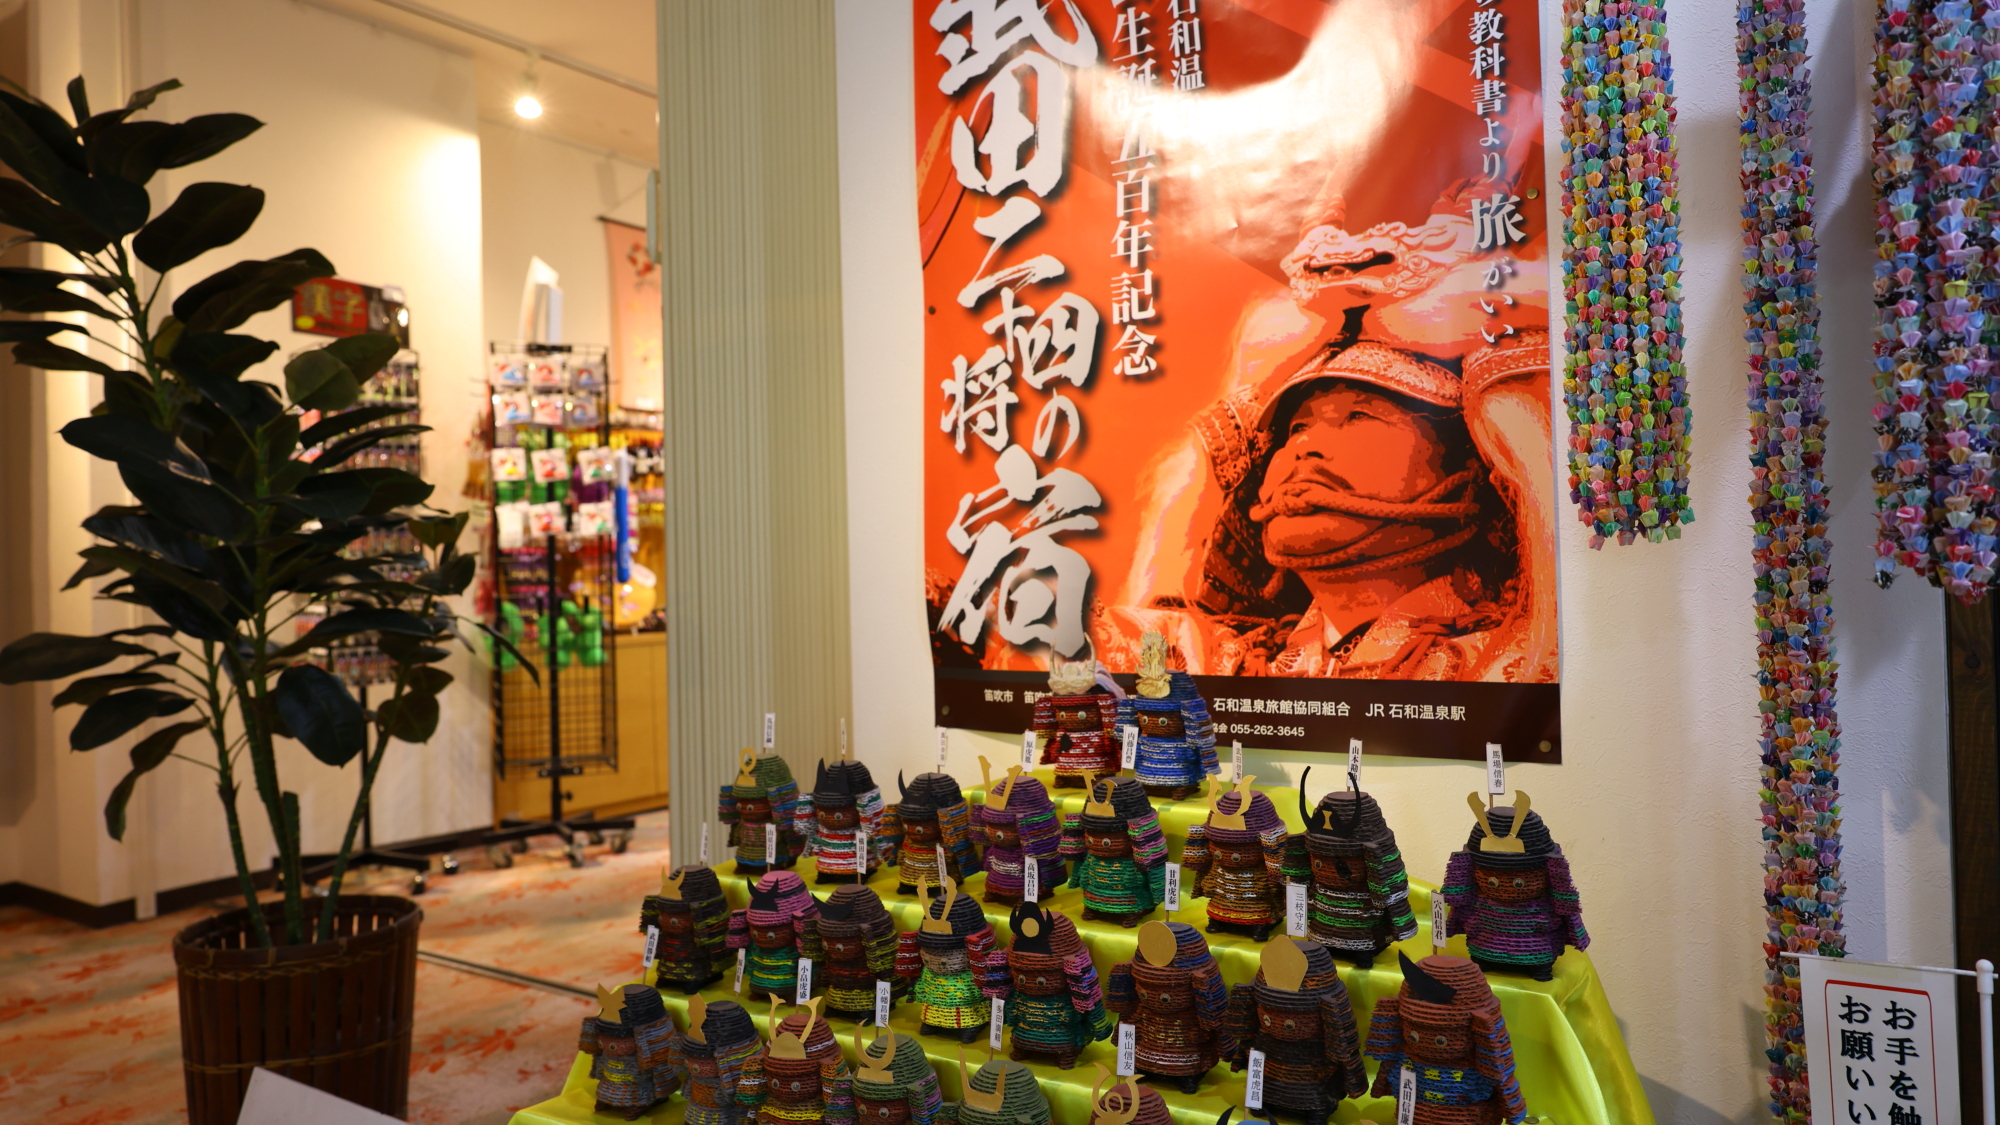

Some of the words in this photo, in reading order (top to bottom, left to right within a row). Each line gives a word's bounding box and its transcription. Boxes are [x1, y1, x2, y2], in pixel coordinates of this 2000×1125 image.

[1110, 0, 1157, 376] 生誕五百年記念
[1466, 0, 1526, 343] 教科書より旅がいい
[984, 689, 1014, 703] 笛吹市
[1213, 697, 1351, 717] 石和温泉旅館協同組合
[1365, 703, 1385, 717] JR
[1389, 703, 1466, 721] 石和温泉駅
[1230, 723, 1305, 737] 055-262-3645
[1492, 750, 1503, 788] 馬場信春
[1027, 863, 1035, 897] 高坂昌信
[1168, 869, 1177, 905] 甘利虎泰
[1294, 892, 1304, 932] 三枝守友
[1433, 899, 1443, 940] 穴山信君
[1124, 1030, 1134, 1070] 秋山信友
[1838, 995, 1877, 1125] お願いい
[1251, 1057, 1263, 1102] 飯富虎昌
